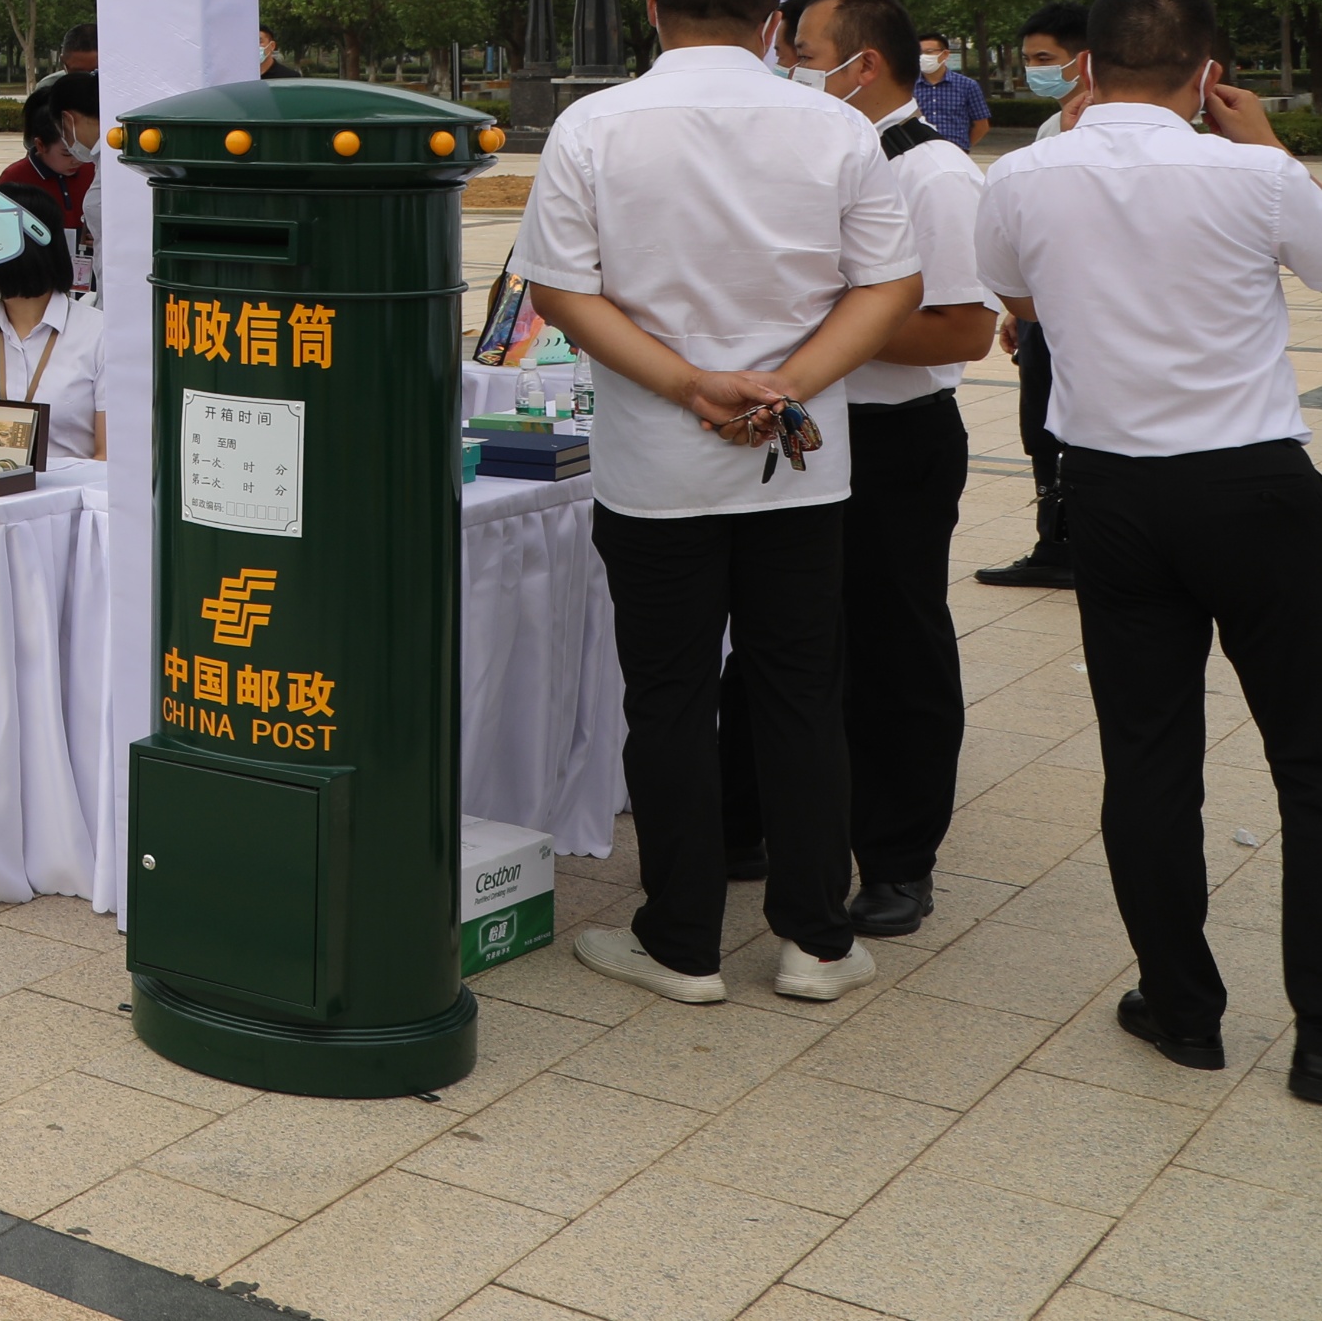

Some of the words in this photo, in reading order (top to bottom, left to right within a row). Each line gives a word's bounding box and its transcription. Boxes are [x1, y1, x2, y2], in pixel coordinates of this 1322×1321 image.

[165, 293, 336, 369] 邮政信筒
[204, 405, 272, 426] 开箱时间
[191, 433, 201, 445] 周
[217, 437, 237, 450] 至周
[243, 461, 255, 474] 时
[275, 464, 288, 476] 分
[243, 482, 255, 494] 时
[274, 484, 288, 497] 分
[164, 646, 336, 718] 中国邮政
[162, 696, 236, 741] CHINA
[252, 718, 337, 752] POST
